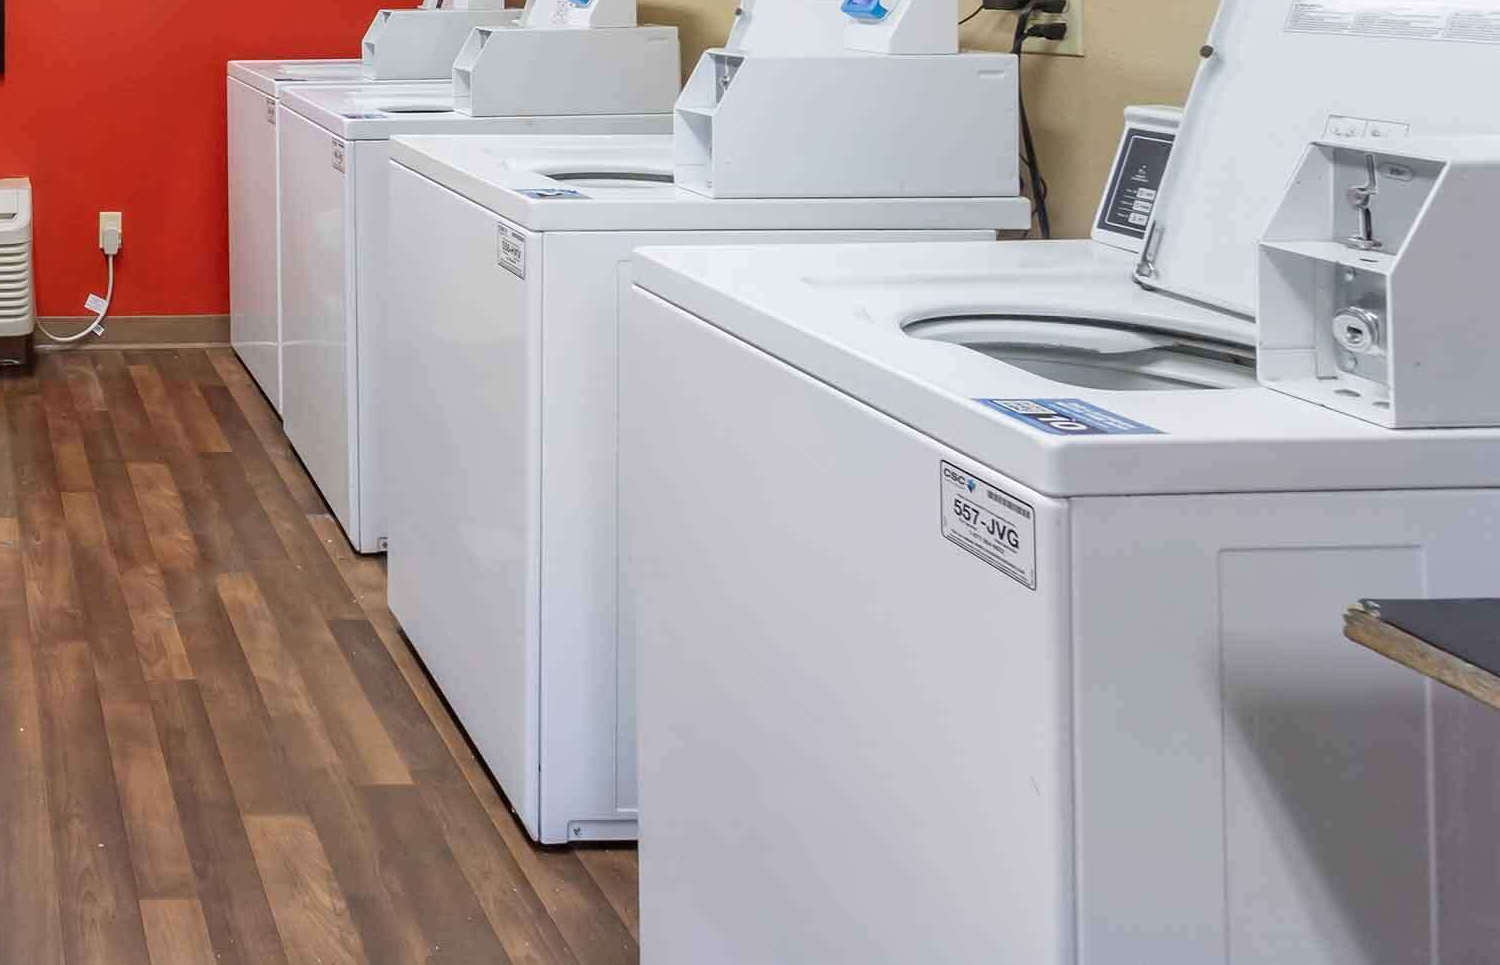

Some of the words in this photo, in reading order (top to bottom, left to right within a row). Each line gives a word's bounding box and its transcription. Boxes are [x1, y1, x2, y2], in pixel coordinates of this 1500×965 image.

[1037, 415, 1089, 431] 10
[943, 468, 966, 485] CSC
[953, 498, 1020, 549] 557-JVG
